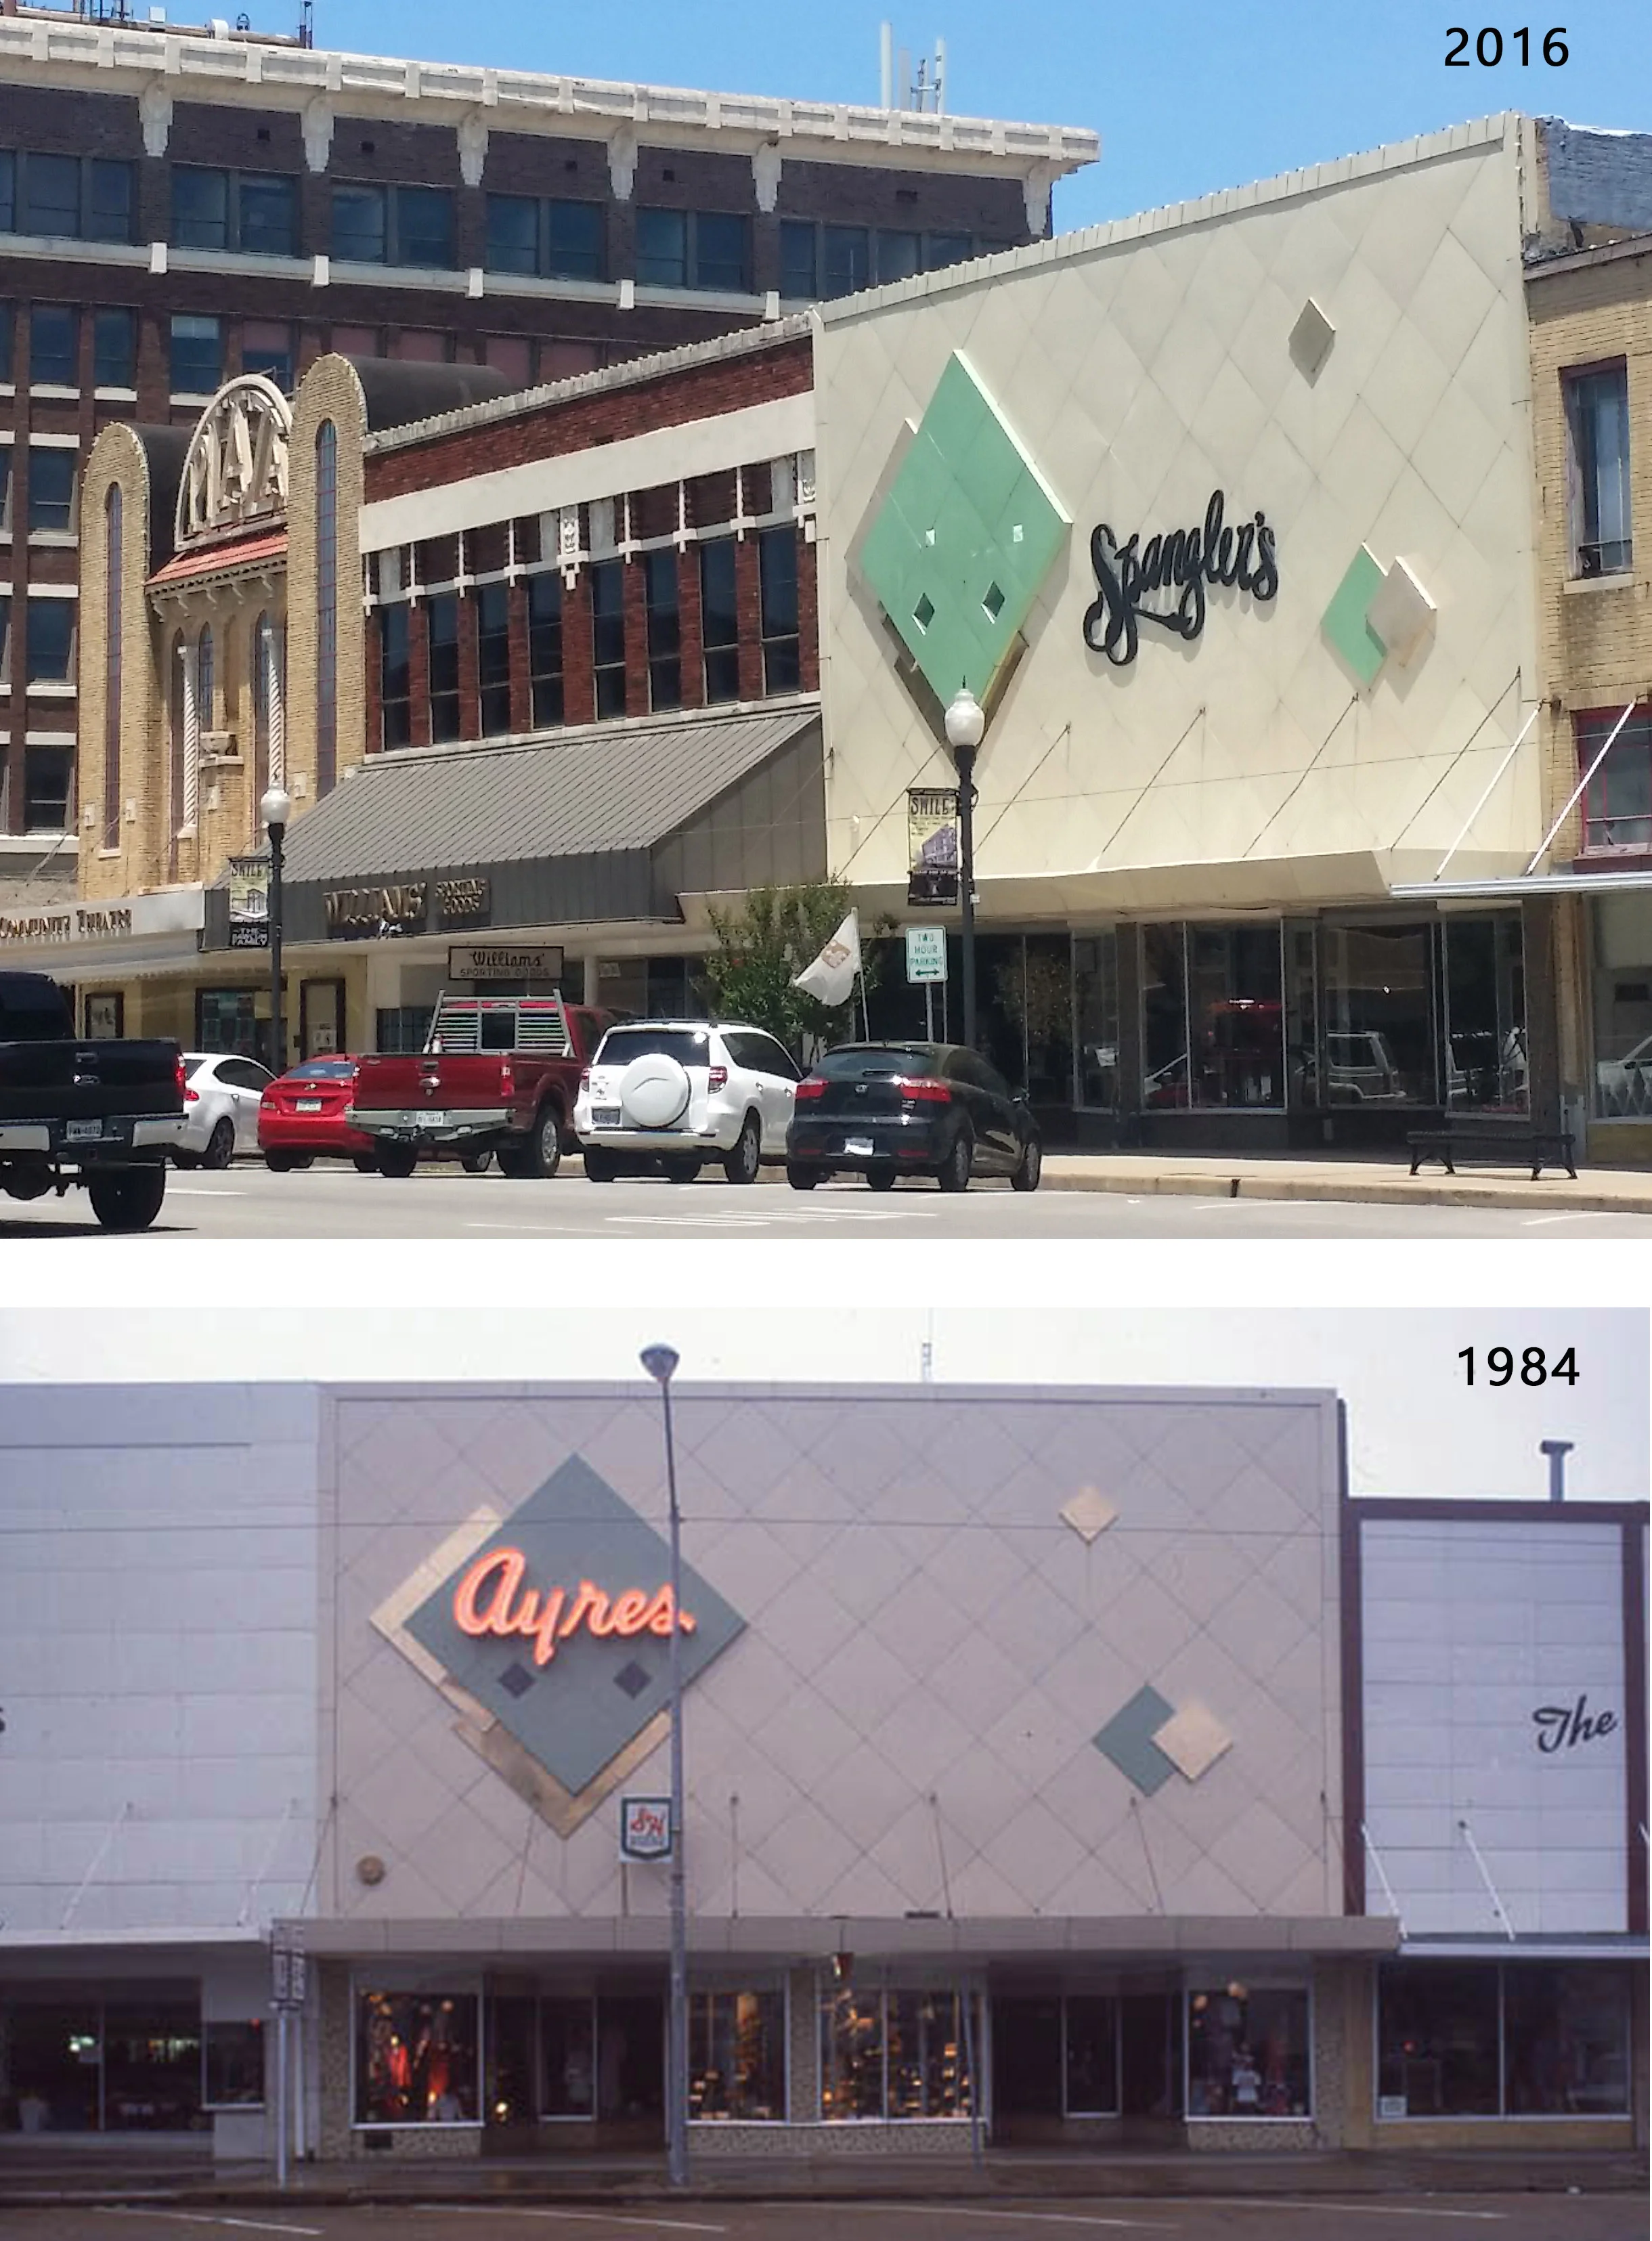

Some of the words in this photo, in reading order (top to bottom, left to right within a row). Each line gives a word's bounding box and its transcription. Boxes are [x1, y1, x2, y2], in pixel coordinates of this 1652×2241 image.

[1083, 489, 1279, 666] Spangler's
[917, 932, 934, 942] TWO
[914, 944, 938, 955] HOUR
[909, 956, 944, 965] PARKING
[460, 967, 510, 978] SPORTING
[516, 967, 550, 977] GOODS
[1532, 1693, 1619, 1754] The
